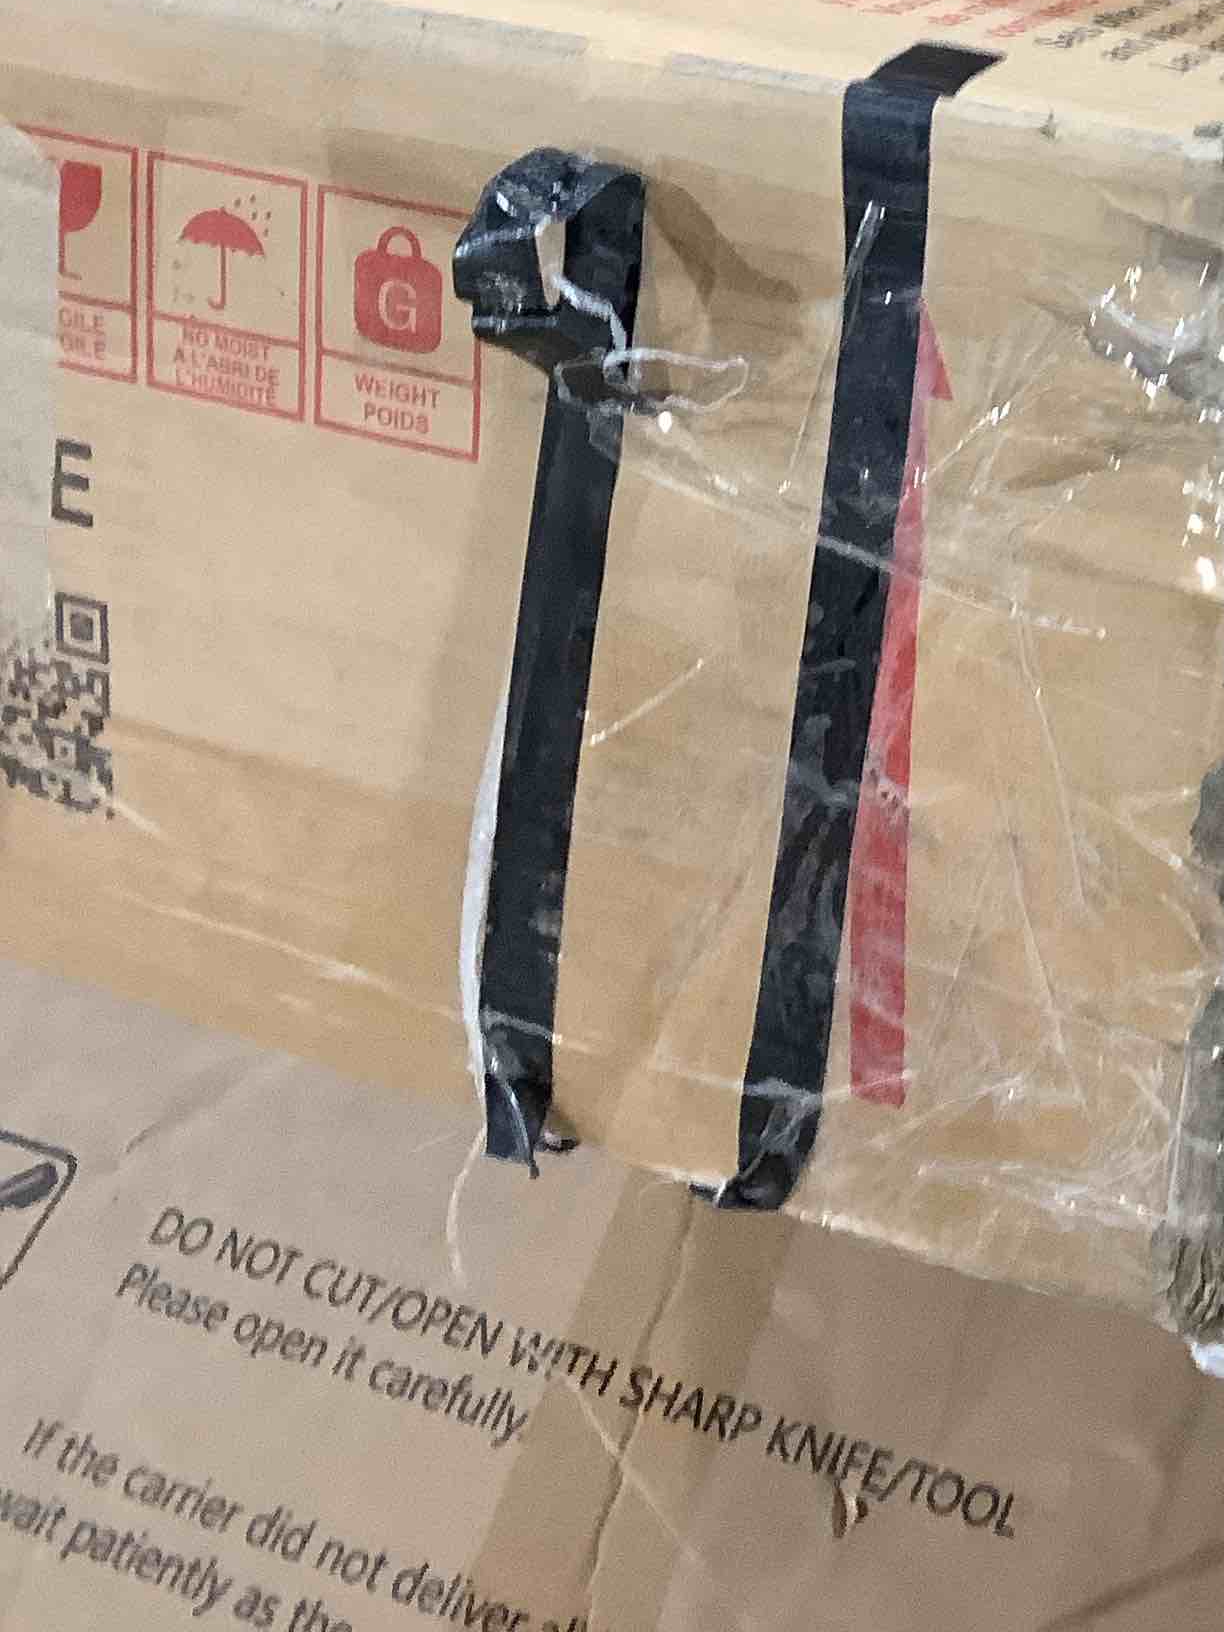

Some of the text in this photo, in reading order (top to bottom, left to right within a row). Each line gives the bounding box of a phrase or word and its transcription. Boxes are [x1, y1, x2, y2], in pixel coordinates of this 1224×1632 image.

[58, 307, 105, 334] GILE
[214, 332, 271, 362] MOIST
[254, 363, 281, 386] DE
[353, 372, 441, 410] WEIGHT
[362, 403, 430, 435] POIDS
[115, 1262, 229, 1331] Please
[233, 1312, 328, 1369] open
[332, 1336, 363, 1381] it
[148, 1206, 1016, 1538] DO NOT CUT/OPEN WITH SHARP KNIFE/TOOL
[22, 1417, 532, 1632] If the carrier did not deliver
[60, 1518, 233, 1618] patiently
[233, 1584, 281, 1628] as
